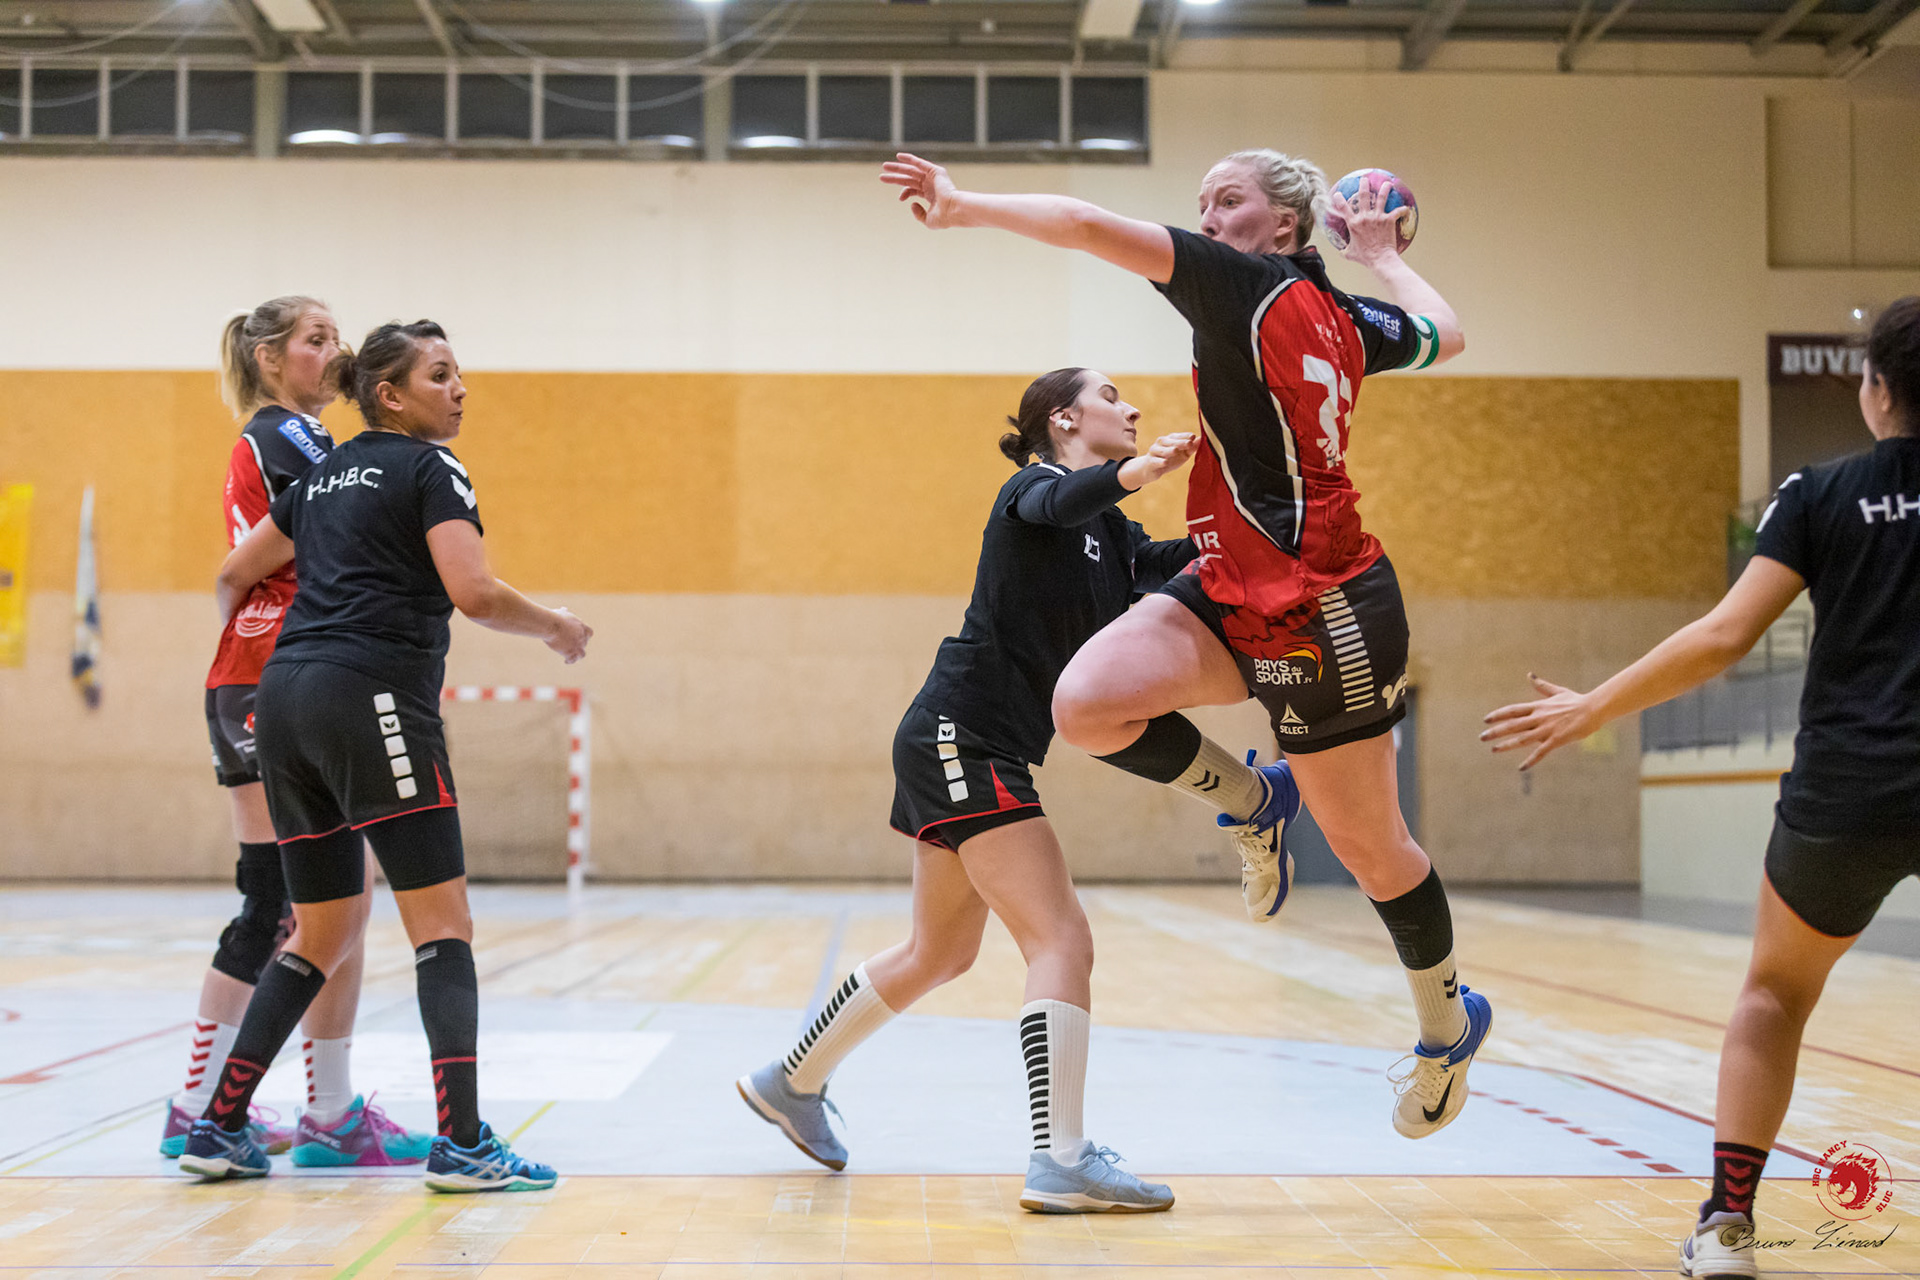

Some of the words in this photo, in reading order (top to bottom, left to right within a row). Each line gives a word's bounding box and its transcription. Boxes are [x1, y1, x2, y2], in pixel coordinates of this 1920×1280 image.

[1254, 658, 1290, 673] PAYS
[1256, 671, 1304, 686] SPORT
[1279, 725, 1309, 735] SELECT
